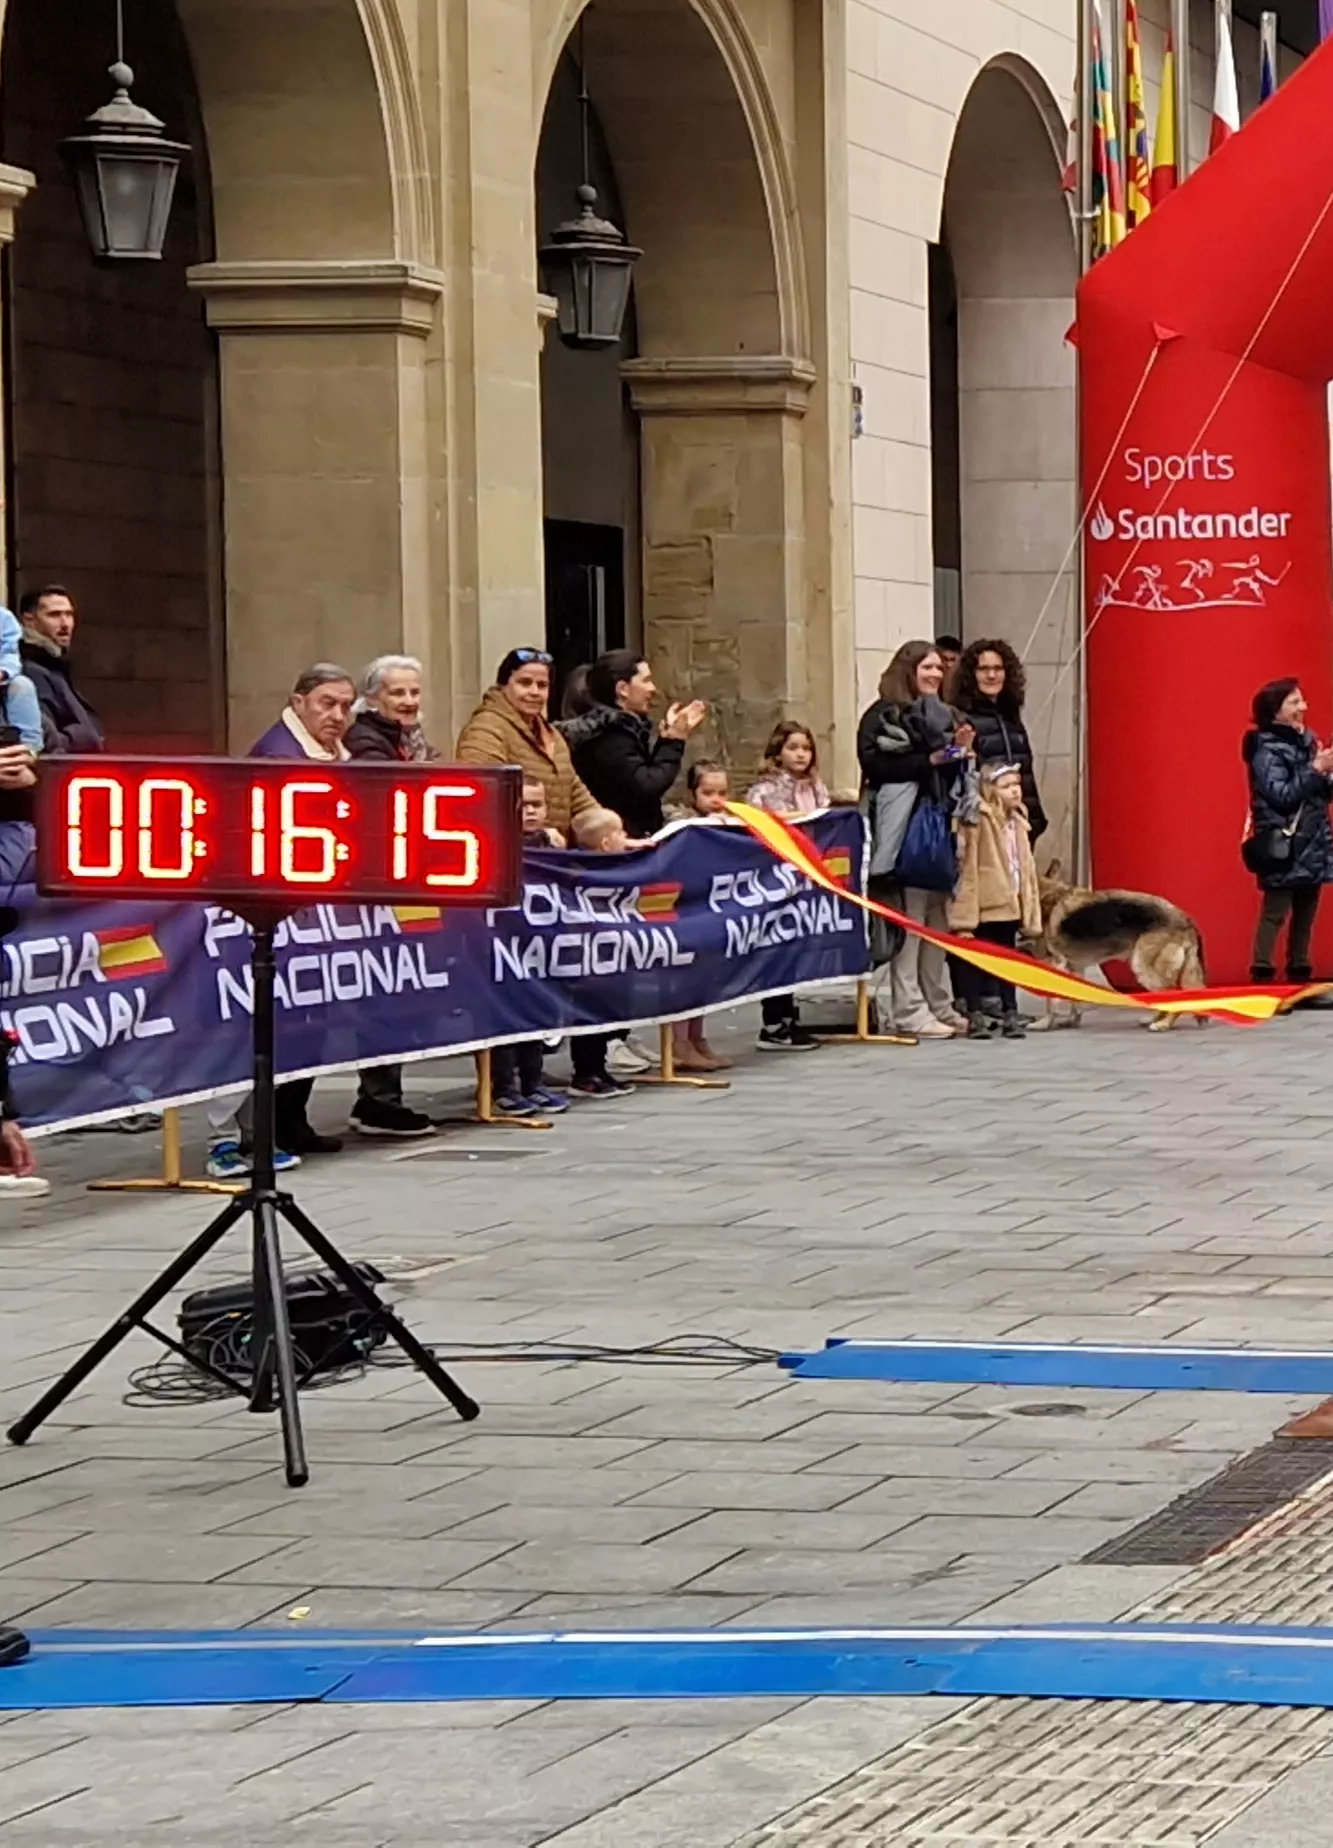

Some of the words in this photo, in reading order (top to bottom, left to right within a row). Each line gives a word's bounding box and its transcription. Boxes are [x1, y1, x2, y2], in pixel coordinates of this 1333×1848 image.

[1123, 447, 1235, 489] Sports
[1117, 506, 1292, 540] Santander
[67, 776, 480, 887] 00:16:15
[708, 861, 814, 914] POLIC
[203, 902, 402, 959] PLICIA
[493, 926, 696, 982] NACIONAL
[724, 893, 853, 960] NACIONAL
[216, 943, 449, 1021] NACIONAL
[0, 986, 176, 1066] IONAL
